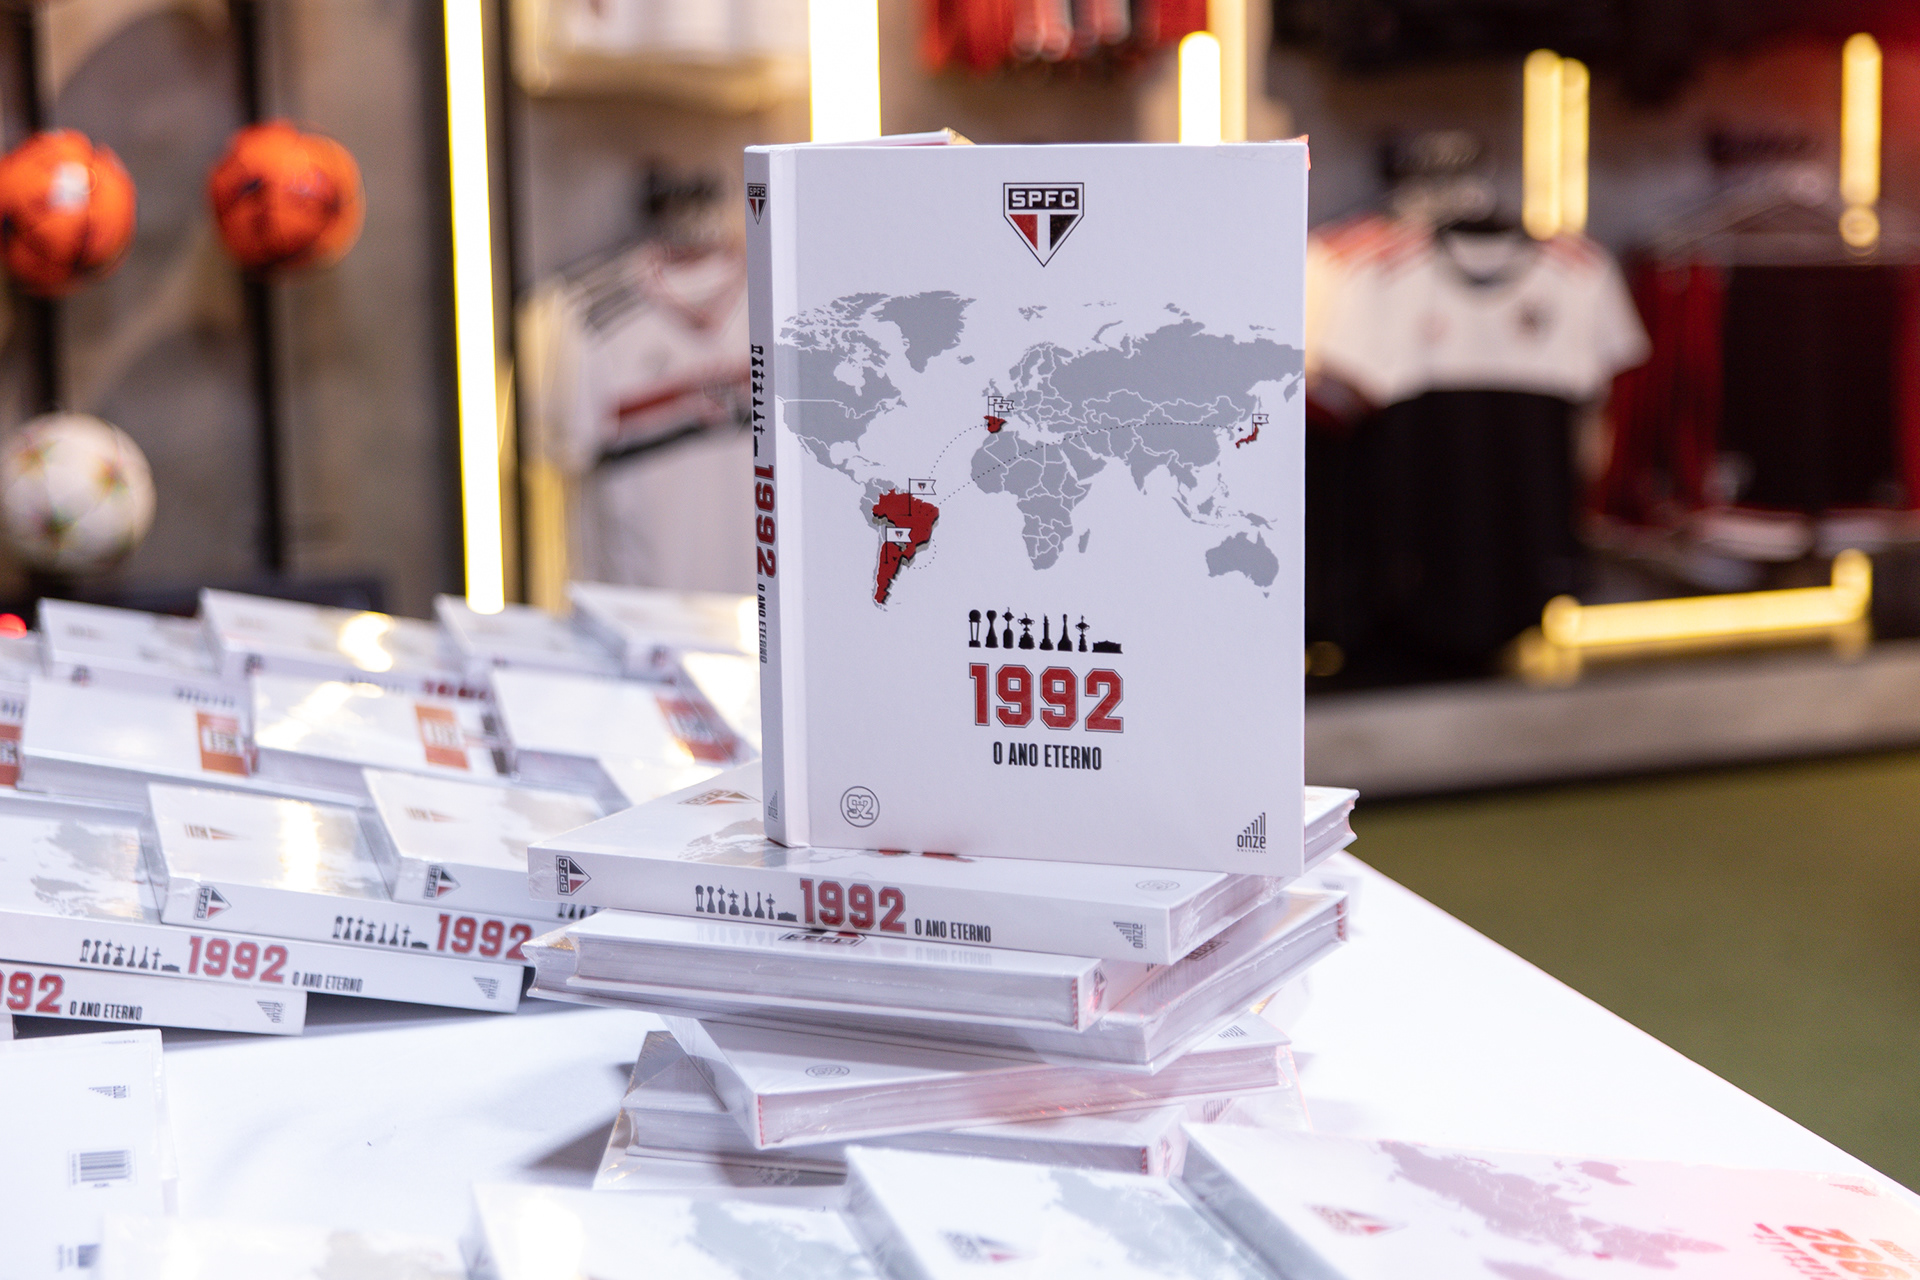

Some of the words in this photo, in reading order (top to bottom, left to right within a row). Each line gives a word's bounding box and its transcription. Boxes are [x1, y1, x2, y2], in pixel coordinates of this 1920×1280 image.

[1011, 190, 1076, 207] SPFC
[754, 464, 777, 578] 1992
[758, 583, 766, 592] O
[758, 594, 766, 618] ANO
[759, 620, 768, 664] ETERNO
[968, 662, 1124, 733] 1992
[993, 741, 1003, 765] O
[1008, 742, 1038, 767] ANO
[1044, 744, 1102, 770] ETERNO
[1237, 834, 1266, 849] onze
[560, 860, 568, 891] SPFC
[799, 877, 907, 934] 1992
[914, 918, 922, 936] O
[926, 919, 947, 938] ANO
[950, 922, 991, 943] ETERNO
[437, 912, 533, 962] 1992
[1132, 923, 1144, 949] onze
[187, 935, 289, 984] 1992
[292, 971, 300, 986] O
[302, 972, 323, 989] ANO
[325, 974, 363, 993] ETERNO
[69, 1000, 77, 1016] O
[80, 1001, 100, 1018] ANO
[104, 1003, 143, 1021] ETERNO
